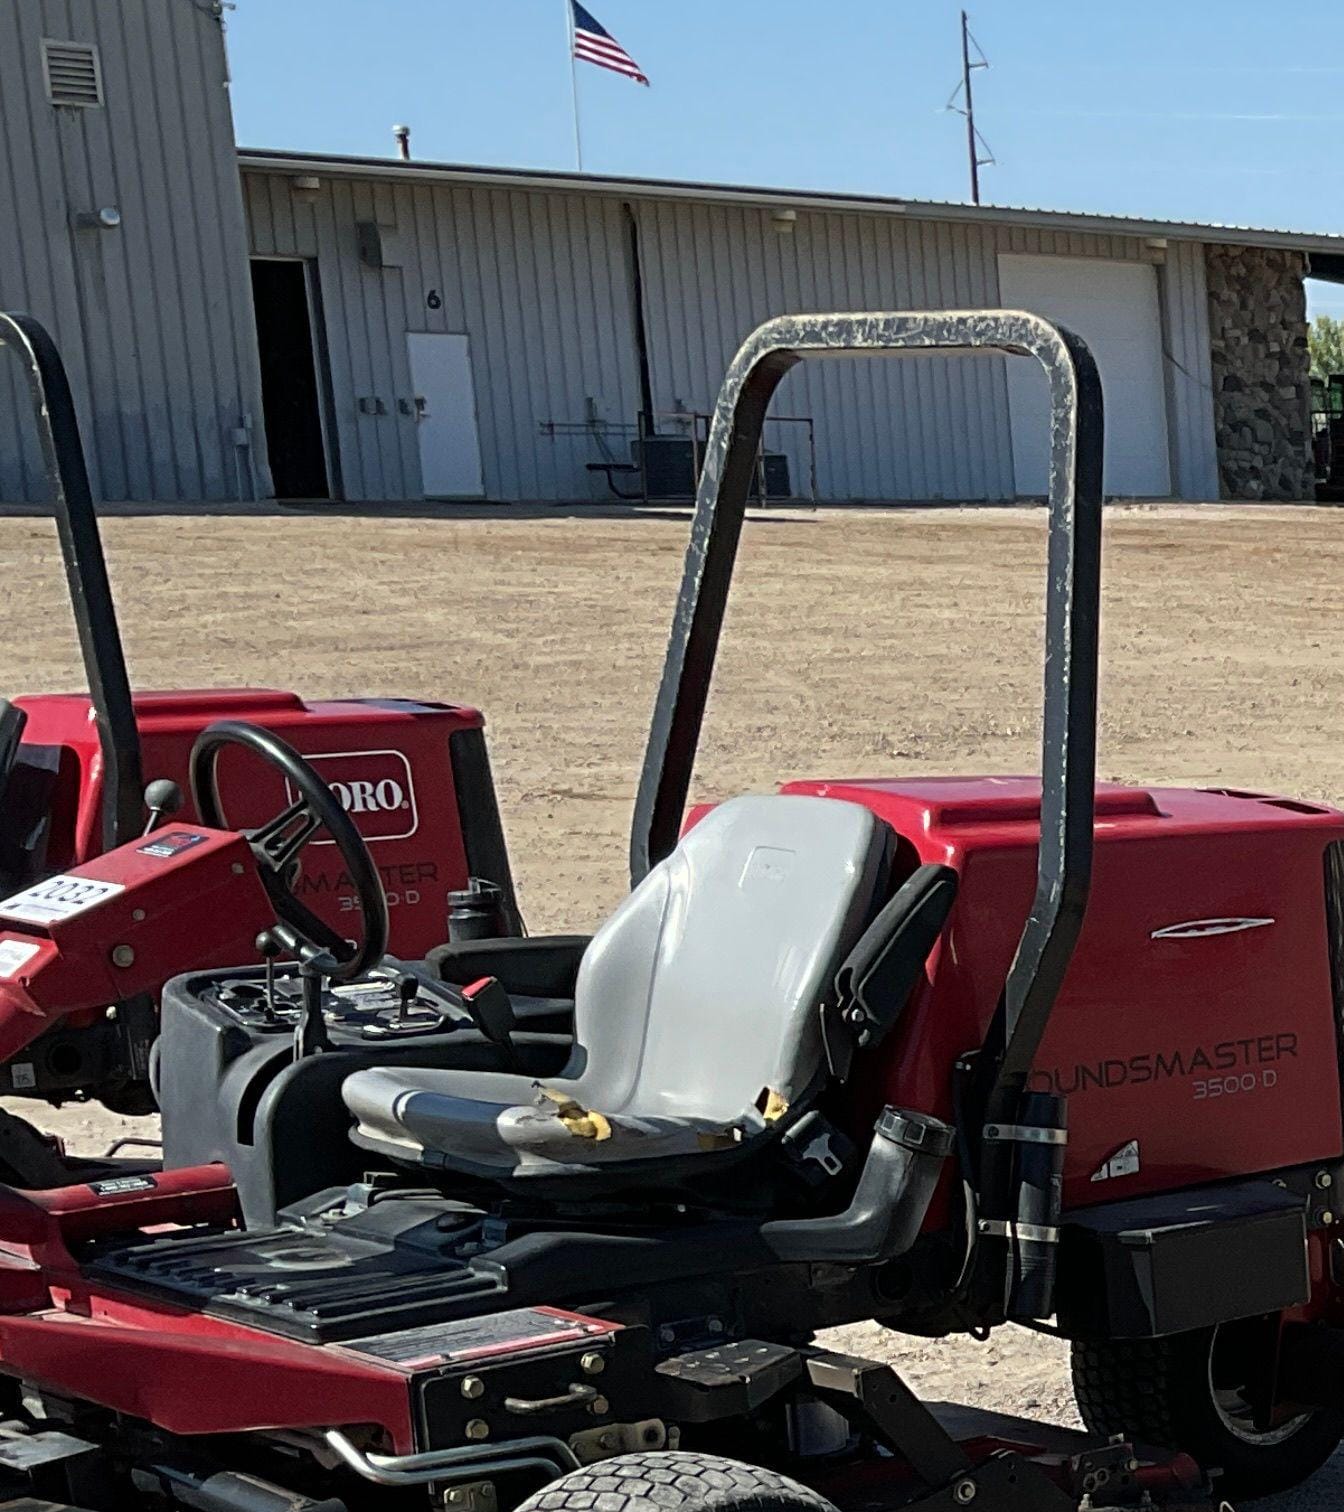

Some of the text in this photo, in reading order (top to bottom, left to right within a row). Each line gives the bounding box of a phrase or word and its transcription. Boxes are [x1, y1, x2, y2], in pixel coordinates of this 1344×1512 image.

[427, 289, 441, 309] 6
[326, 779, 404, 813] ORO
[28, 880, 109, 905] 2032
[1027, 1033, 1298, 1095] OUNDSMASTER
